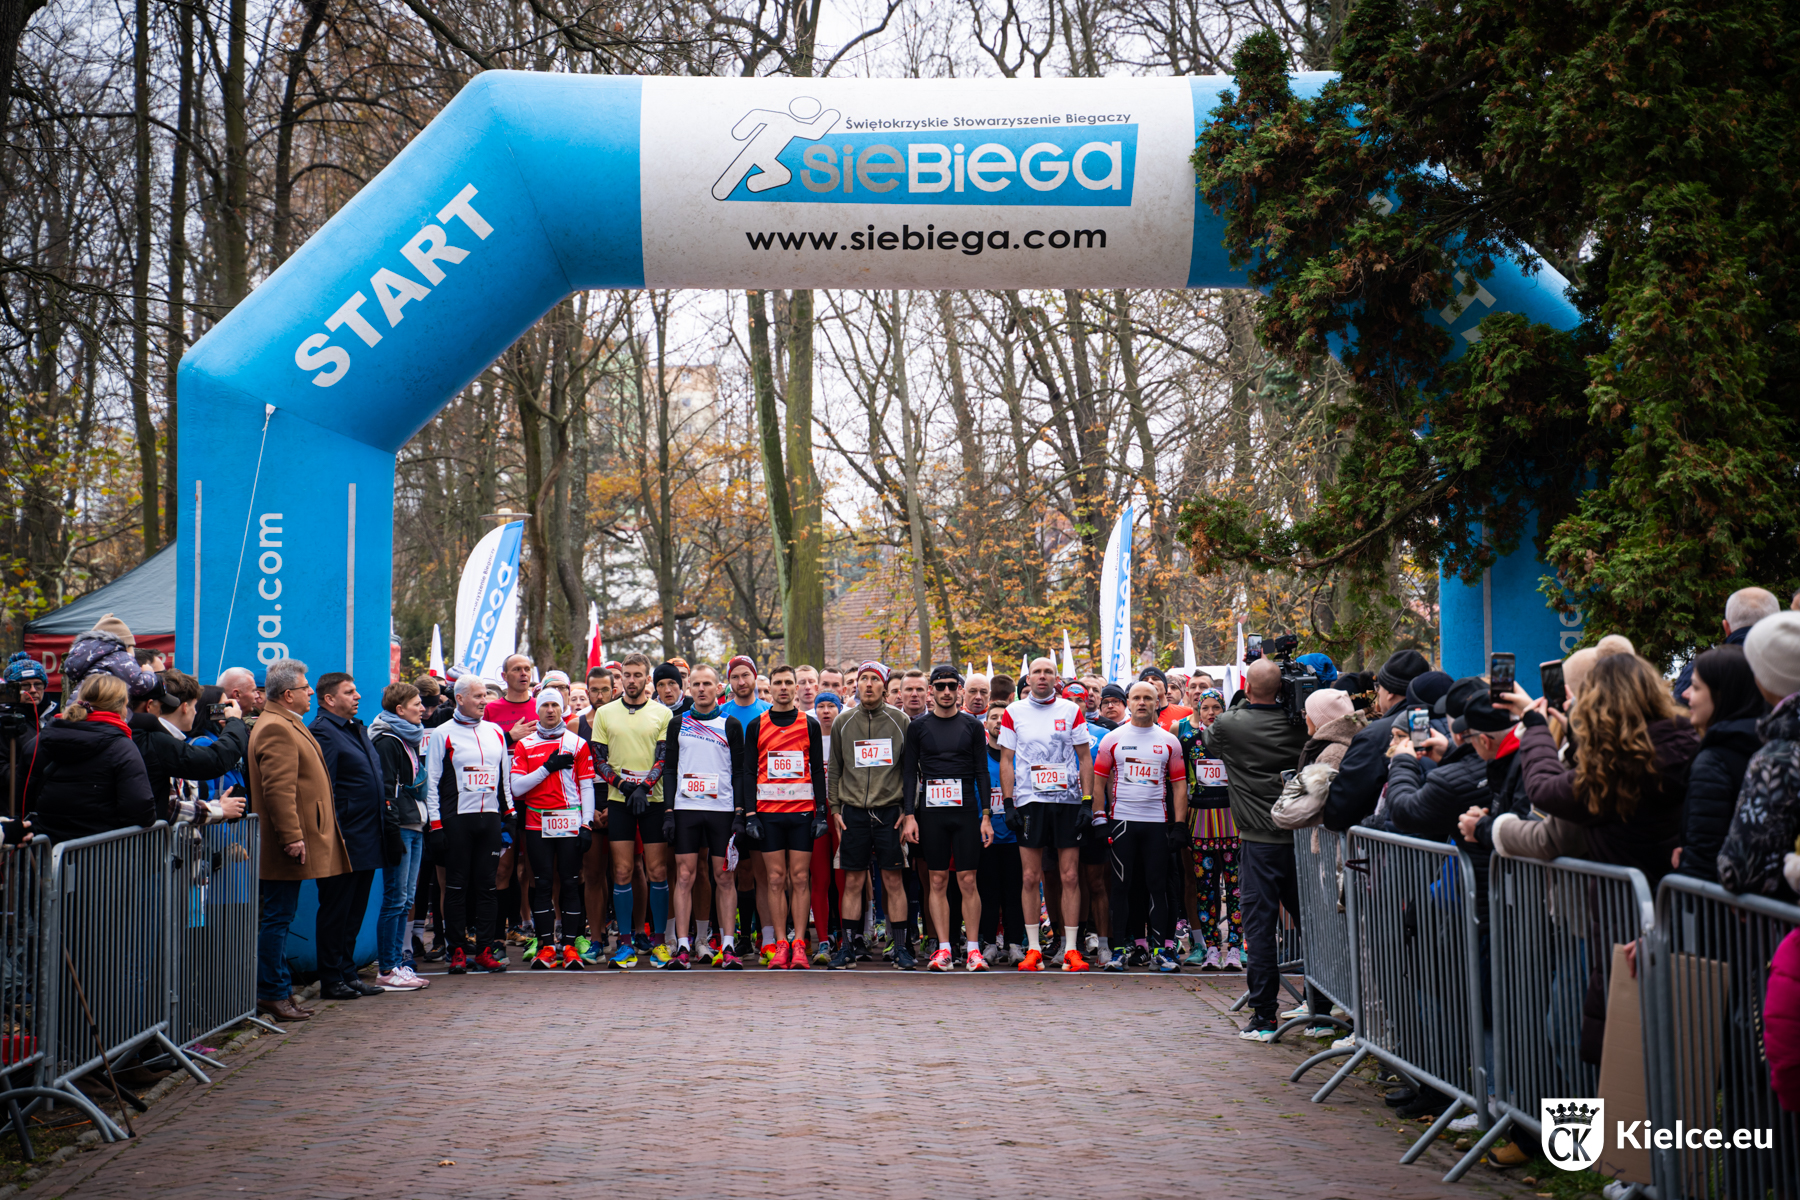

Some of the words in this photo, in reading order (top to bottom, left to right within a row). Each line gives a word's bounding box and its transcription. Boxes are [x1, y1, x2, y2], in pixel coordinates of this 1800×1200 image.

[845, 116, 949, 132] Świętokrzyskie
[953, 113, 1061, 128] Stowarzyszenie
[1065, 112, 1131, 125] Biegaczy
[746, 224, 1107, 256] www.siebiega.com
[294, 182, 494, 388] START
[861, 746, 879, 759] 647
[773, 758, 792, 771] 666
[1129, 764, 1151, 778] 1144
[467, 773, 489, 785] 1122
[1036, 771, 1058, 784] 1229
[1203, 766, 1221, 779] 730
[687, 780, 705, 793] 985
[931, 786, 952, 799] 1115
[546, 817, 569, 830] 1033
